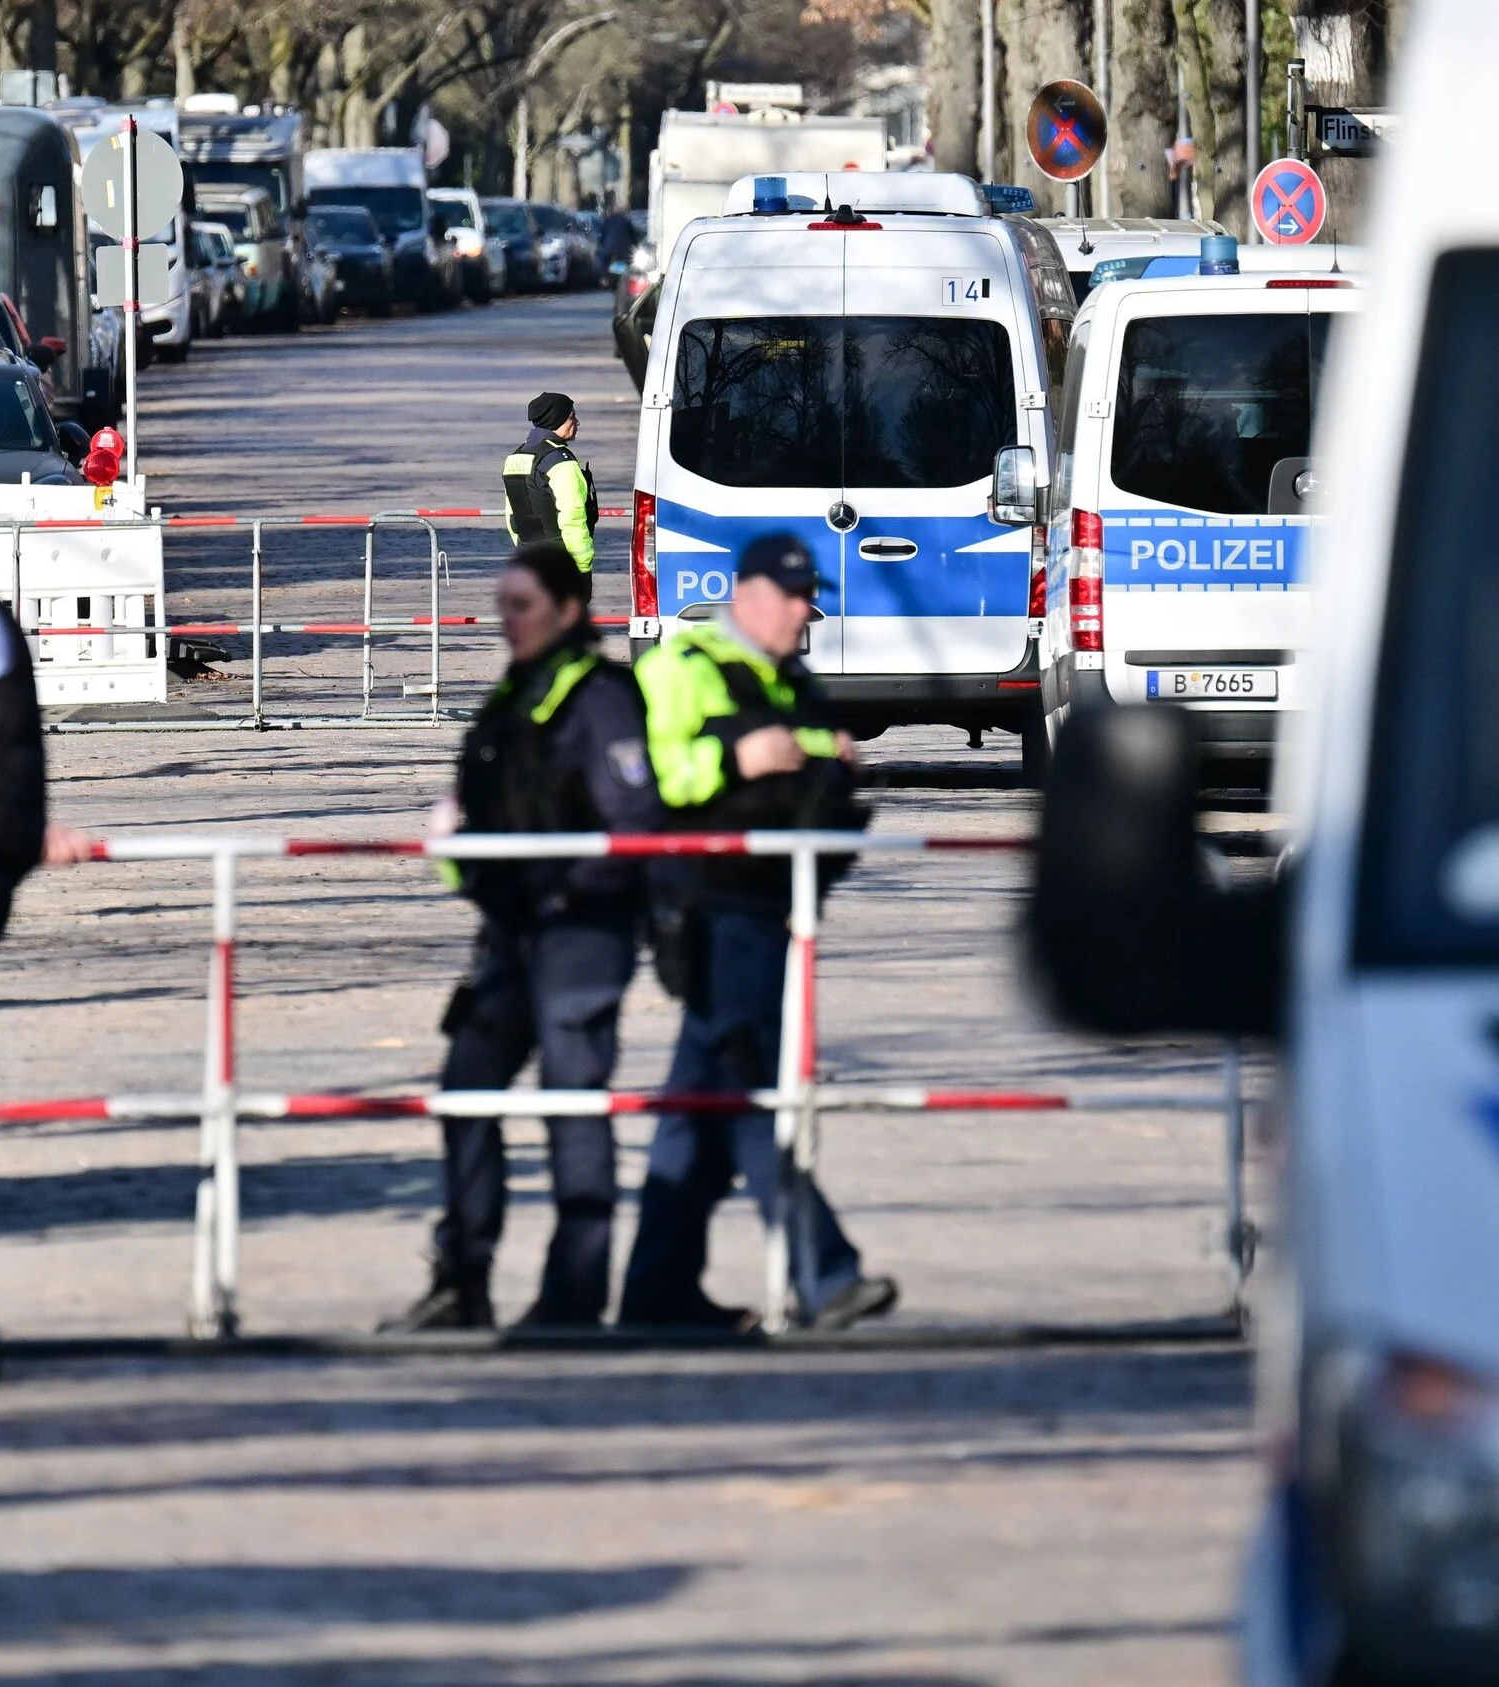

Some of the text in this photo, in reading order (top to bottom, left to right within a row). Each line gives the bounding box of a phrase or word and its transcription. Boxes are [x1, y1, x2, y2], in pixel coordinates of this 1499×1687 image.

[947, 280, 979, 303] 14
[1130, 539, 1285, 571] POLIZEI
[1173, 673, 1254, 694] B 7665
